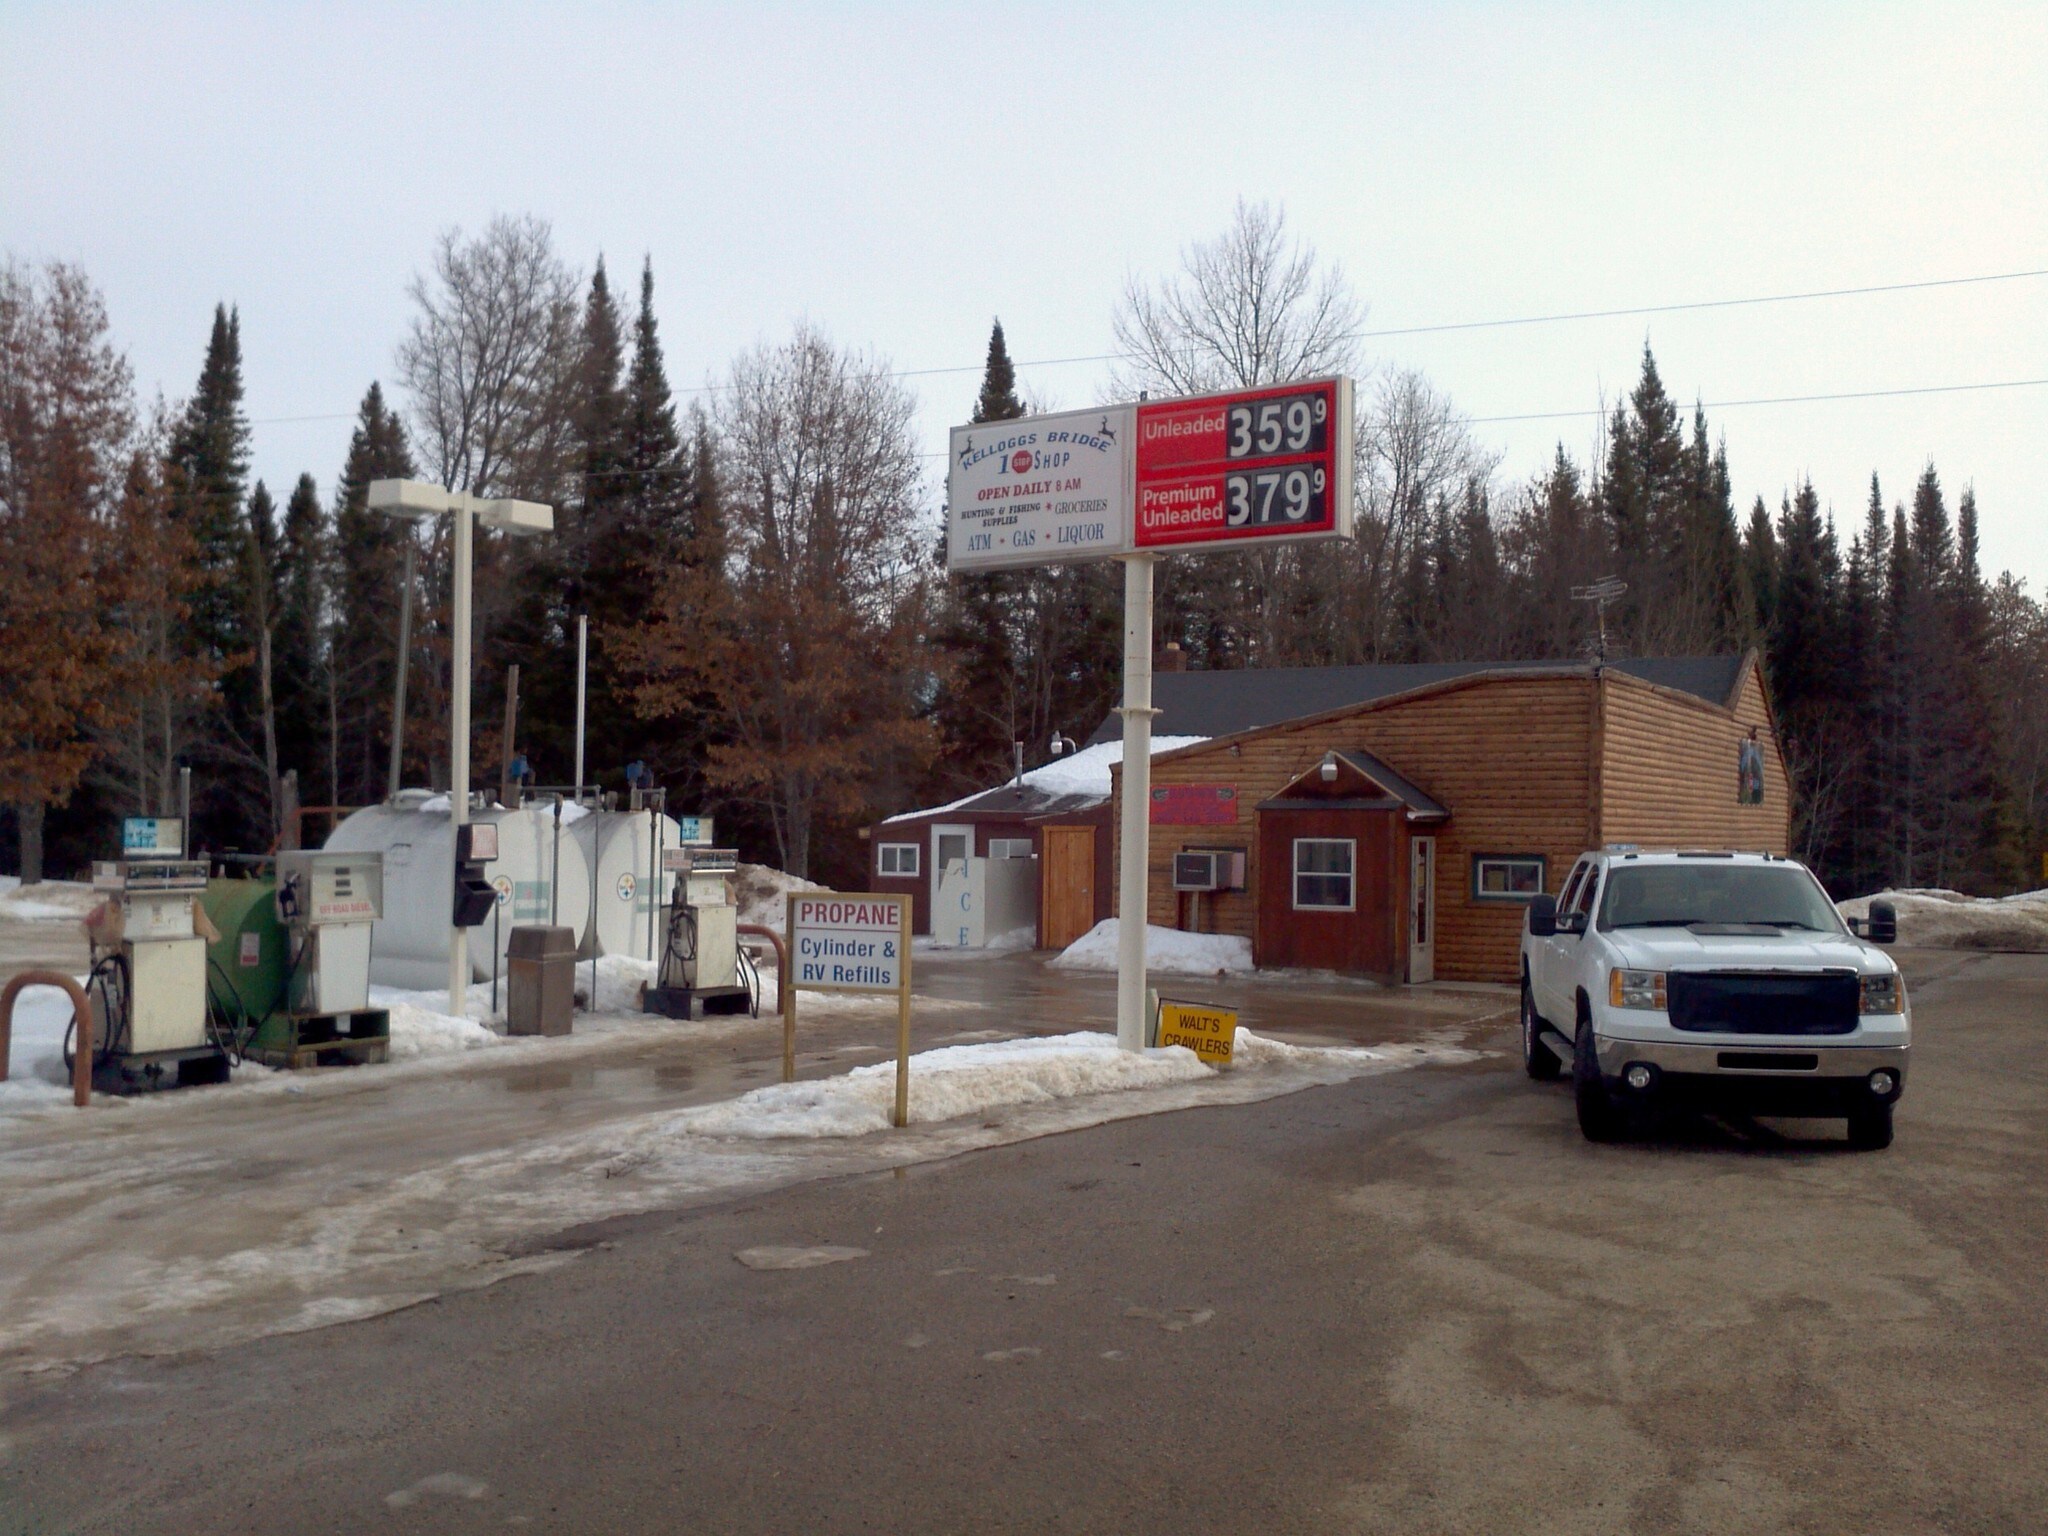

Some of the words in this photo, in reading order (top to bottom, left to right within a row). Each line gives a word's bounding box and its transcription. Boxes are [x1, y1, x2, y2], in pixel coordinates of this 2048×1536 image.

[1145, 412, 1225, 439] Unleaded
[962, 433, 1037, 470] KELLOGGS
[1047, 431, 1111, 453] BRIDGE
[998, 454, 1010, 474] 1
[1013, 456, 1031, 467] STOP
[1034, 450, 1070, 470] SHOP
[977, 486, 1010, 501] OPEN
[1013, 480, 1052, 497] DAILY
[1056, 481, 1062, 492] 8
[1064, 478, 1082, 491] AM
[1143, 483, 1216, 507] Premium
[961, 507, 995, 520] HUNTING
[998, 505, 1005, 515] &
[1009, 502, 1041, 514] FISHING
[1055, 499, 1108, 515] GROCERIES
[1143, 501, 1223, 527] Unleaded
[982, 515, 1018, 528] SUPPLIES
[967, 534, 992, 552] ATM
[1013, 529, 1036, 547] GAS
[1058, 523, 1104, 544] LIQUOR
[801, 902, 899, 925] PROPANE
[801, 937, 875, 958] Cylinder
[883, 941, 896, 958] &
[803, 963, 825, 981] RV
[833, 964, 891, 984] Refills
[1179, 1014, 1220, 1033] WALT'S
[1164, 1033, 1230, 1056] CRAWLERS
